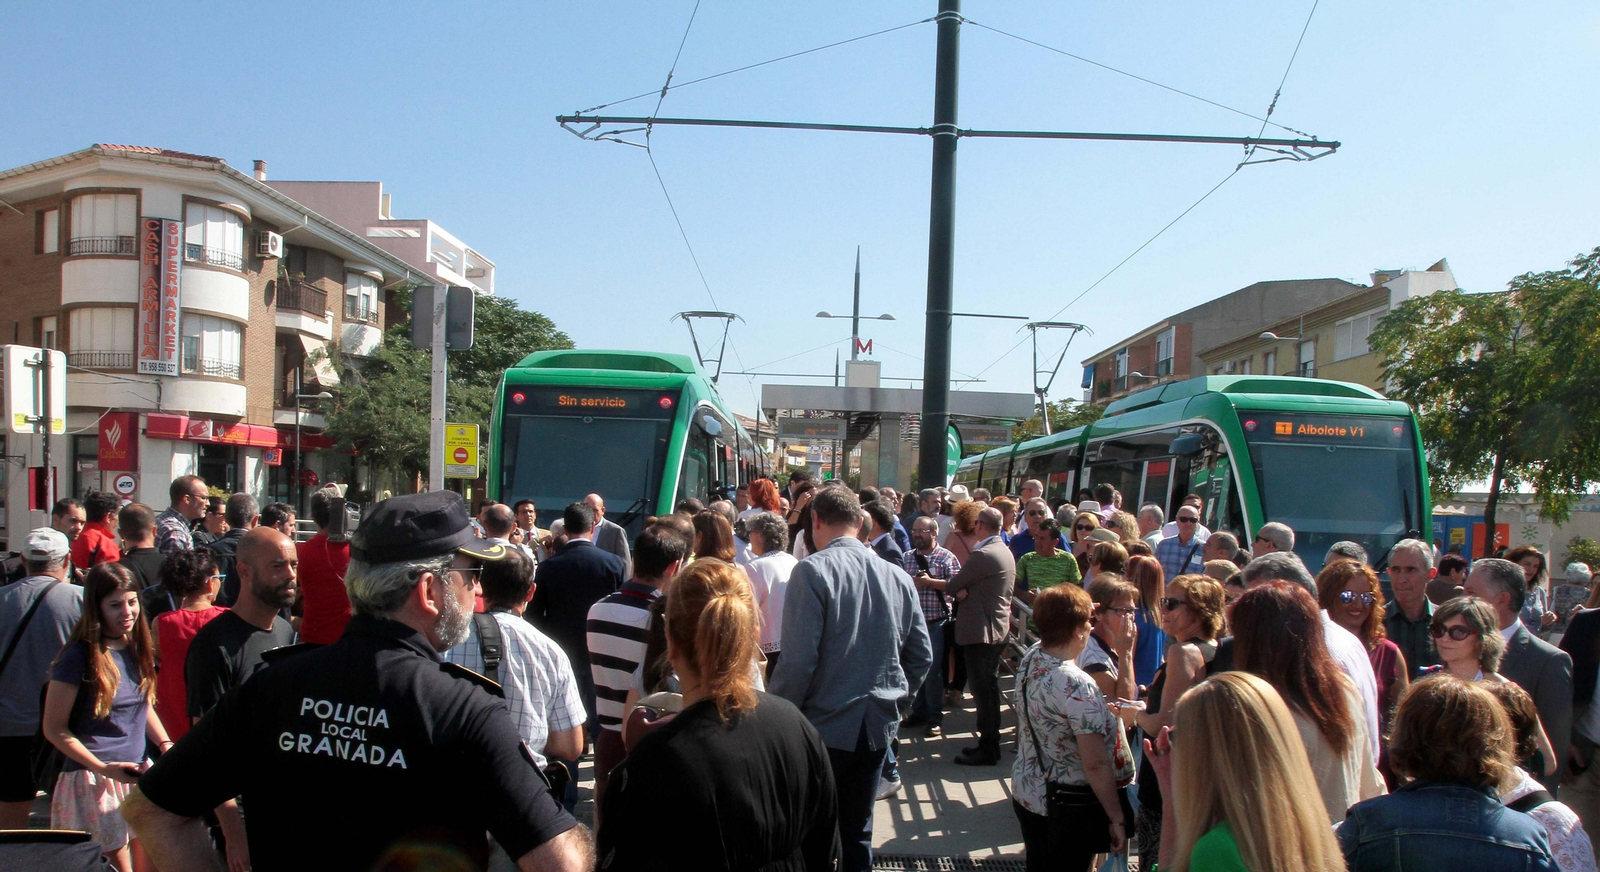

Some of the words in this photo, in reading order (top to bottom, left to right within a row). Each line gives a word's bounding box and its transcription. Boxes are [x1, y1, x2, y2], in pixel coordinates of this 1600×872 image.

[144, 219, 159, 266] CASH
[164, 222, 179, 360] SUPERMARKET
[141, 277, 159, 357] ARMILLA
[856, 337, 872, 355] M
[167, 363, 176, 373] 527
[558, 394, 577, 406] Sin
[580, 396, 626, 408] servicio
[1297, 424, 1347, 436] Albolote
[1349, 426, 1364, 437] V1
[300, 697, 390, 729] POLICIA
[321, 722, 367, 741] LOCAL
[278, 731, 407, 769] GRANADA
